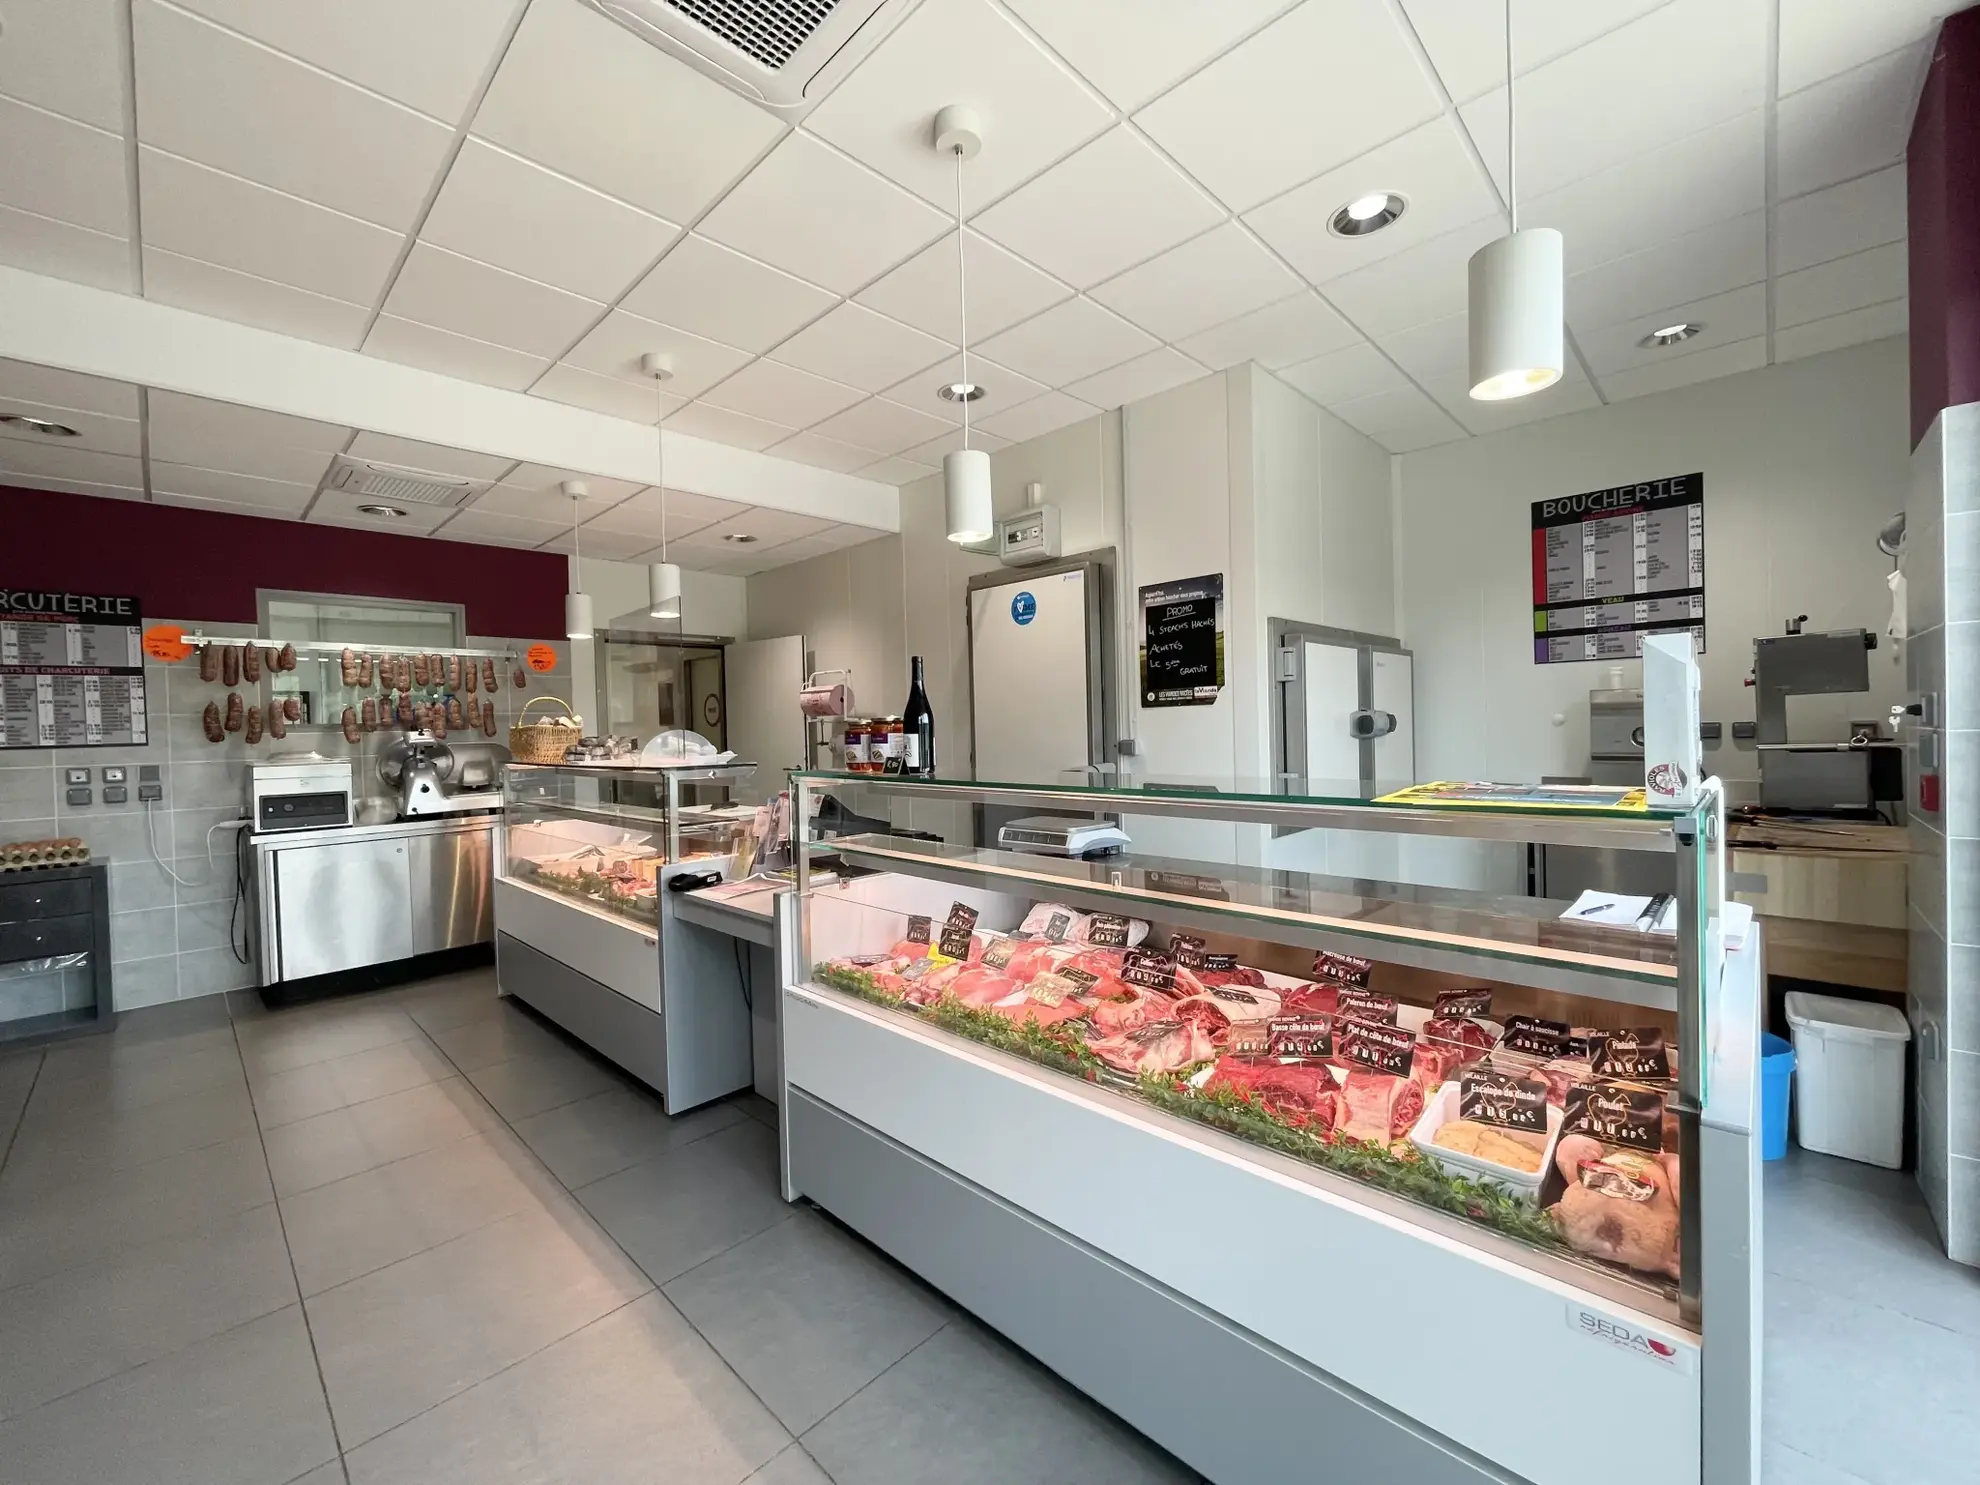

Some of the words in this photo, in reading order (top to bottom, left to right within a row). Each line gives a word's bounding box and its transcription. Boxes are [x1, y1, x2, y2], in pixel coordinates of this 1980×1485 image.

[1543, 477, 1687, 518] BOUCHERIE
[1602, 596, 1624, 604] VEAU
[1166, 604, 1193, 617] PROMO
[1148, 625, 1155, 636] 4
[41, 666, 110, 675] CHARCUTERIE
[1271, 1023, 1288, 1031] Basse
[1302, 1022, 1309, 1030] de
[1515, 1022, 1530, 1030] Chair
[1535, 1026, 1560, 1036] saucisse
[1347, 1023, 1360, 1035] Plat
[1360, 1028, 1368, 1036] de
[1383, 1034, 1392, 1044] de
[1471, 1083, 1502, 1097] Escalope
[1504, 1088, 1514, 1097] de
[1515, 1090, 1536, 1100] dinde
[1598, 1098, 1625, 1111] Poulet
[1580, 1311, 1648, 1349] SEDA
